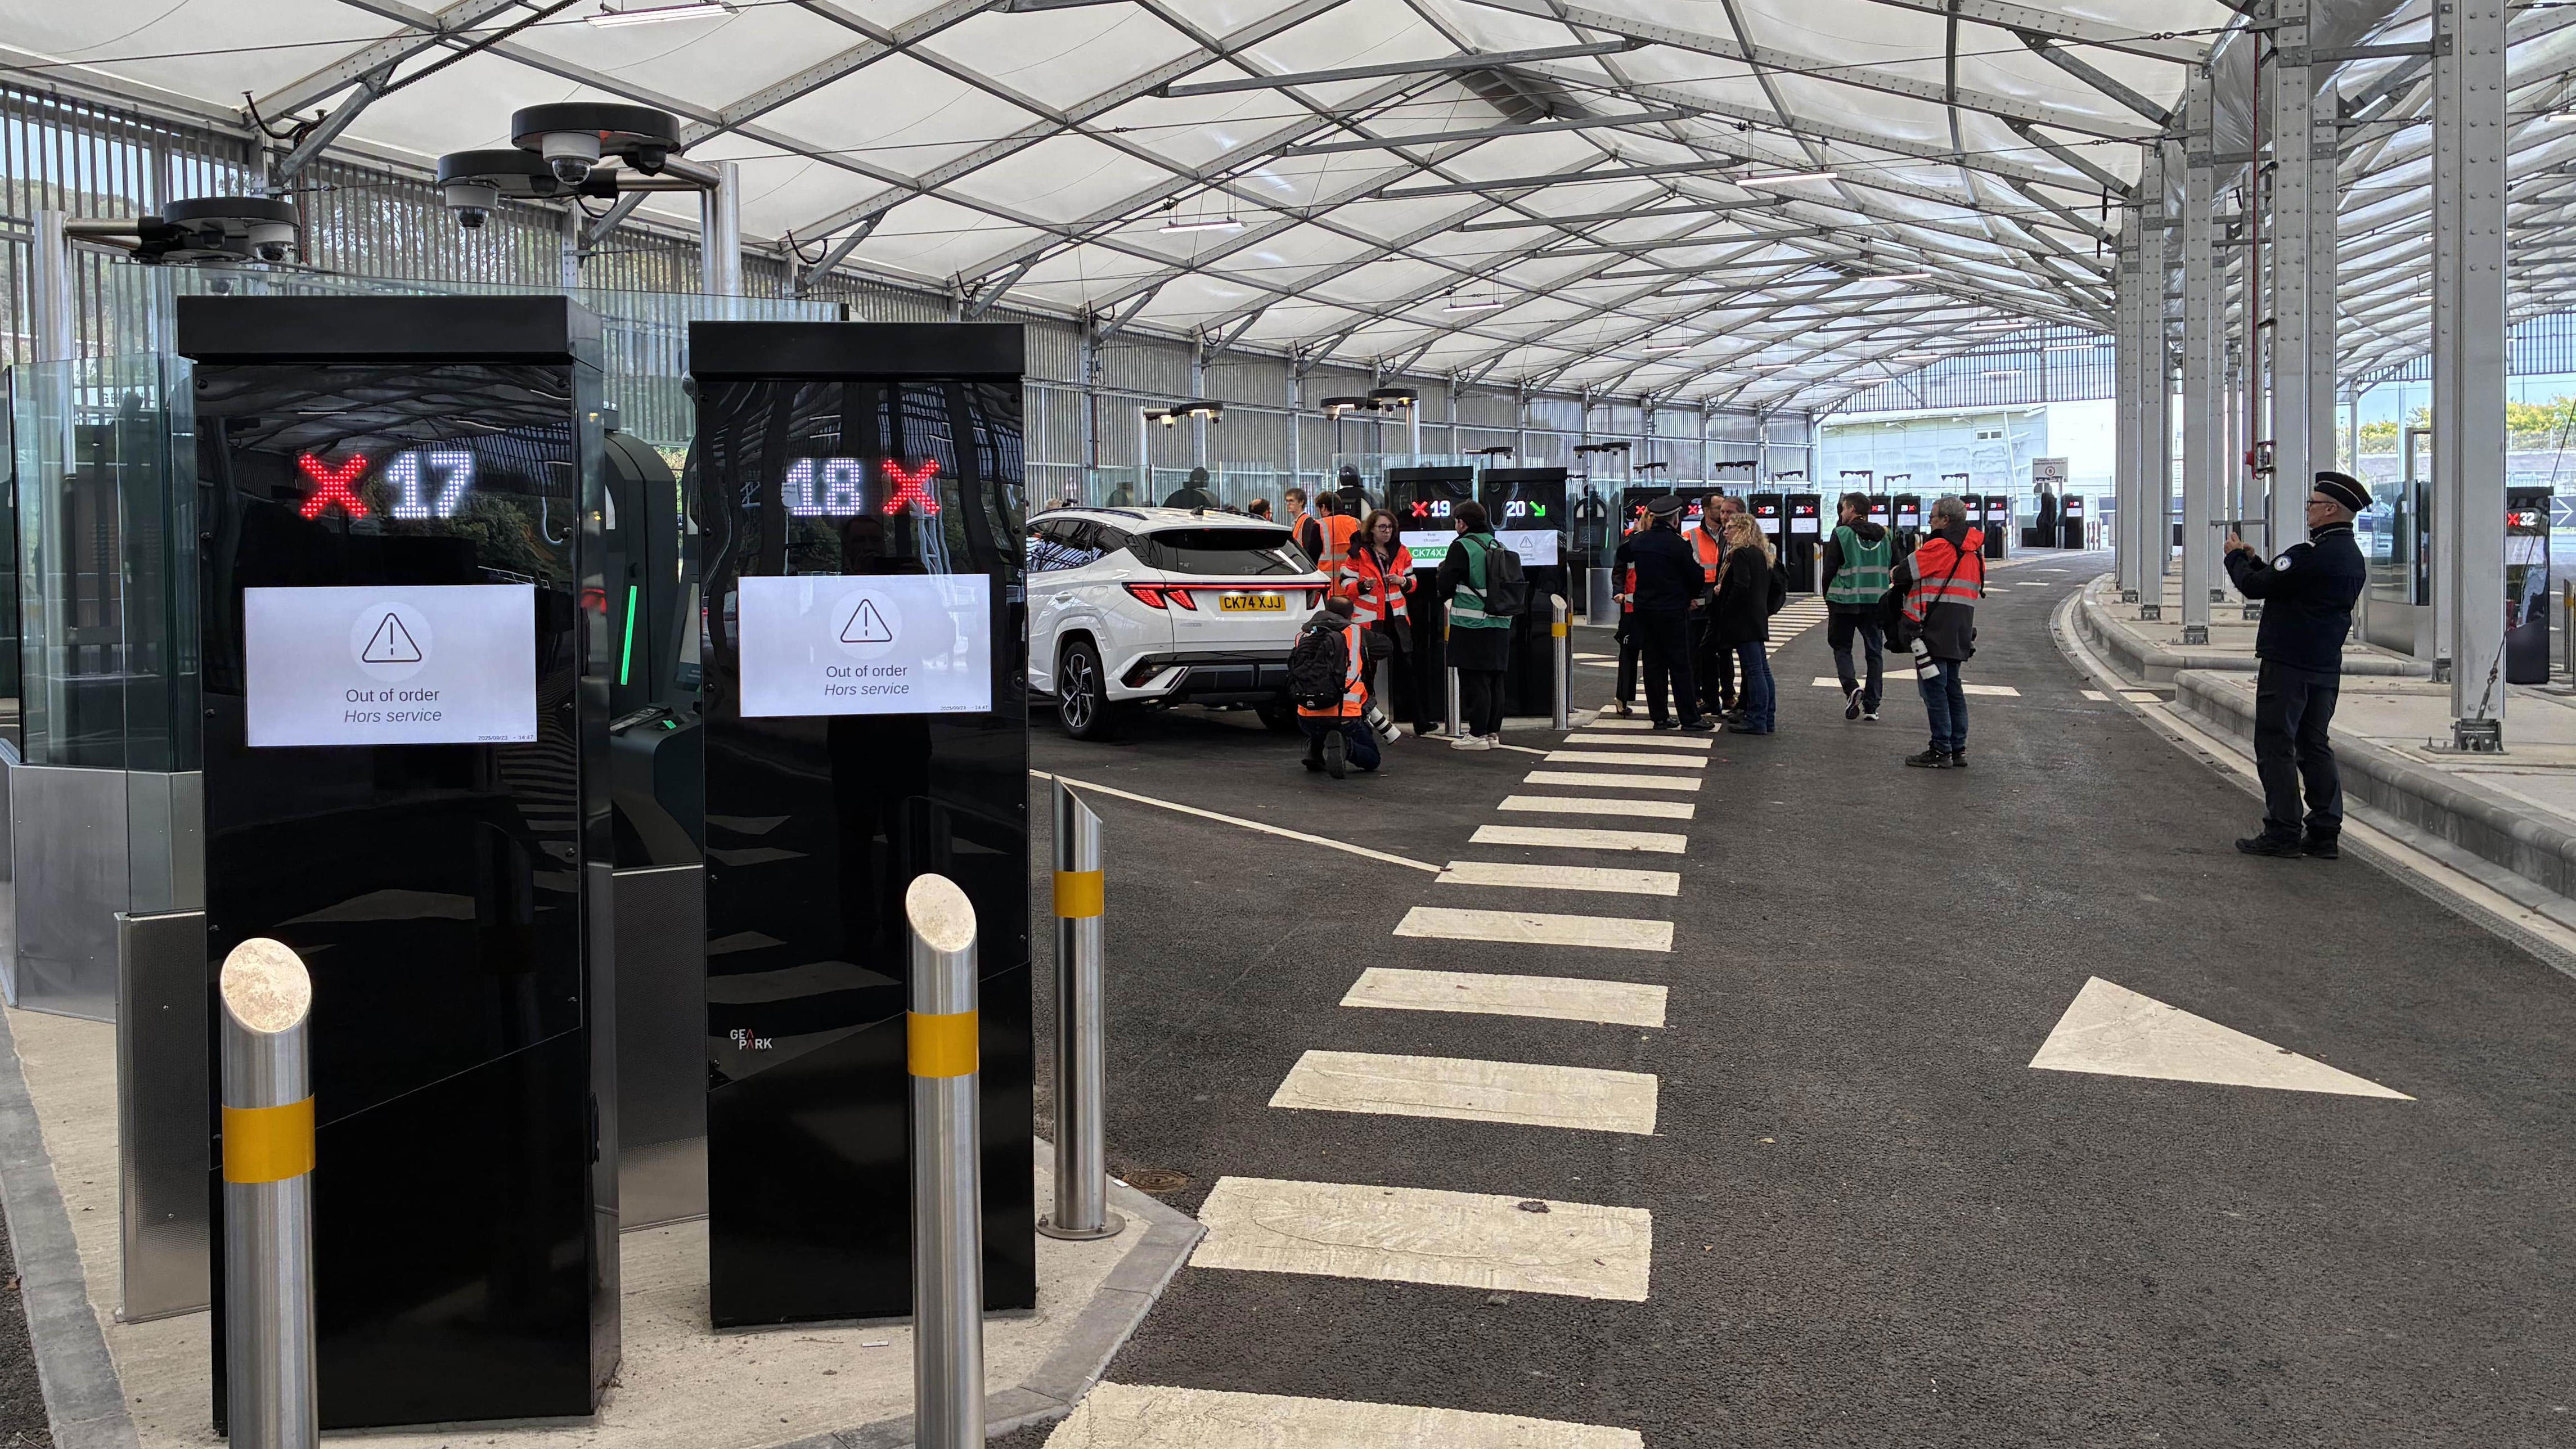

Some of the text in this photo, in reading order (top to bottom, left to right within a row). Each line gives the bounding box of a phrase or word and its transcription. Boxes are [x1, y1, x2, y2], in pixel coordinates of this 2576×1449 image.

[388, 451, 471, 519] 17
[786, 458, 860, 516] 18
[1430, 500, 1450, 517] 19
[1505, 500, 1526, 517] 20
[2519, 512, 2537, 526] 32
[1411, 548, 1447, 557] CK74XJ
[1224, 597, 1281, 609] CK74 XJJ
[826, 665, 908, 678] Out of order
[346, 687, 440, 703] Out of order
[825, 682, 909, 696] Hors service
[344, 708, 442, 723] Hors service
[739, 1038, 773, 1050] PARK
